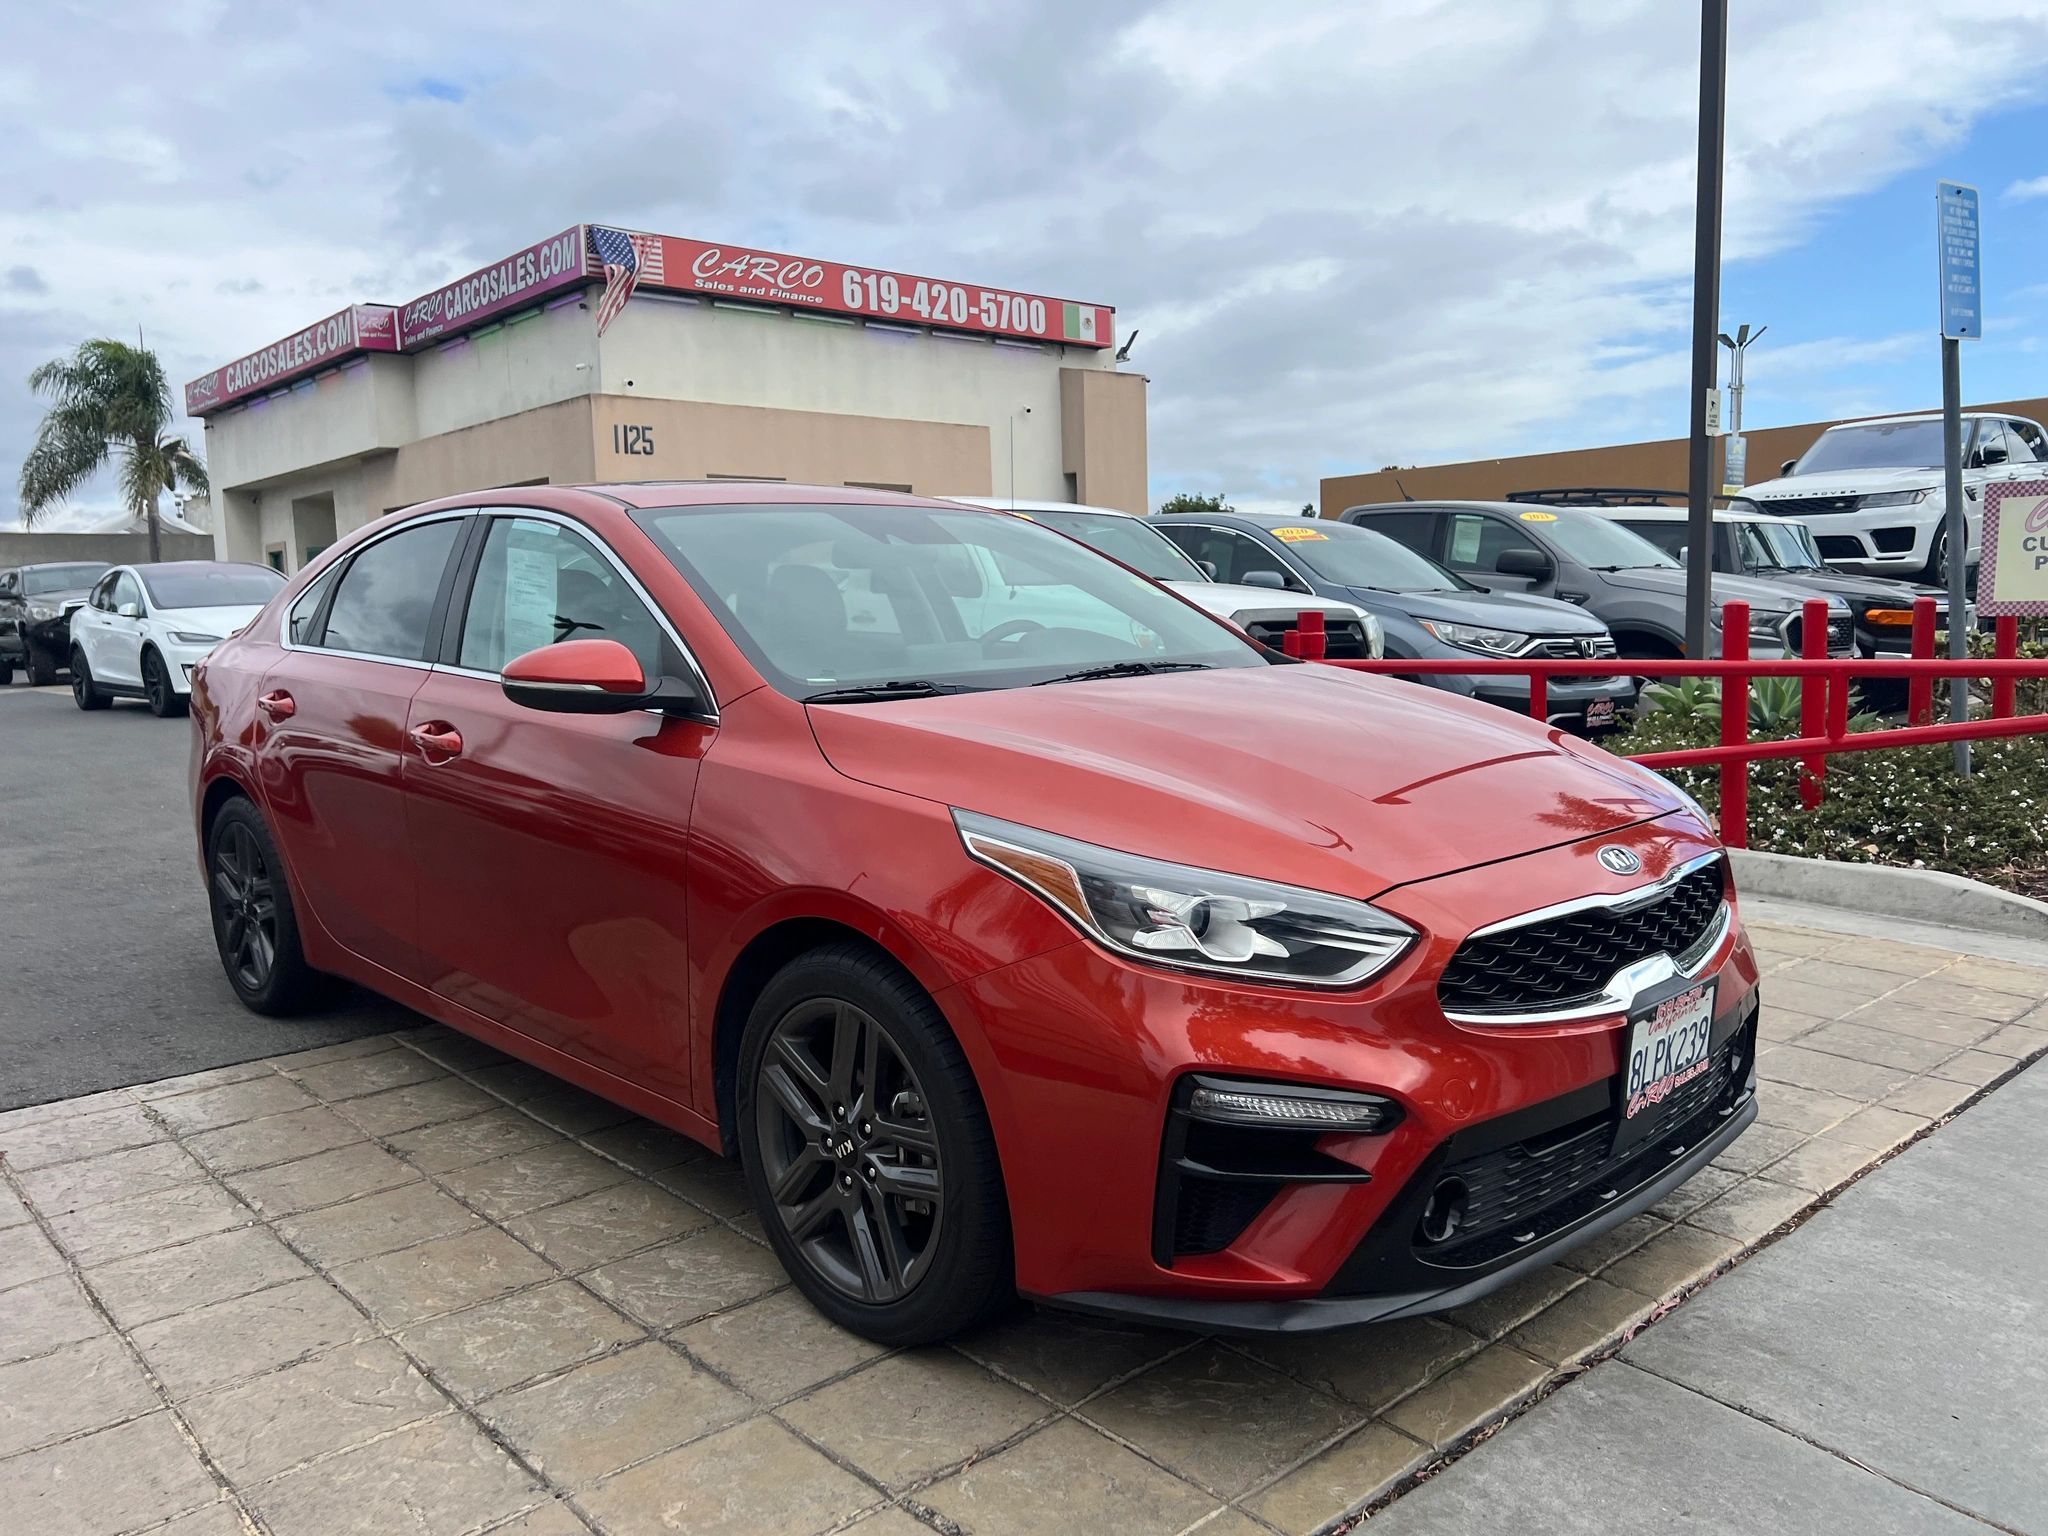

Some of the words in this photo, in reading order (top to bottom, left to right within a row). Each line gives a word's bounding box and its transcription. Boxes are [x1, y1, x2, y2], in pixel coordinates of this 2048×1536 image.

[444, 232, 576, 321] CARCOSALES.COM
[692, 249, 824, 289] CARCO
[694, 278, 734, 292] Sales
[738, 285, 766, 296] and
[769, 288, 824, 304] Finance
[842, 270, 1046, 335] 619-420-5700
[403, 293, 443, 333] CARCO
[226, 311, 351, 394] CARCOSALES.COM
[613, 424, 654, 456] 1125
[1603, 849, 1639, 869] KIA
[1630, 1015, 1709, 1094] 8LPK239
